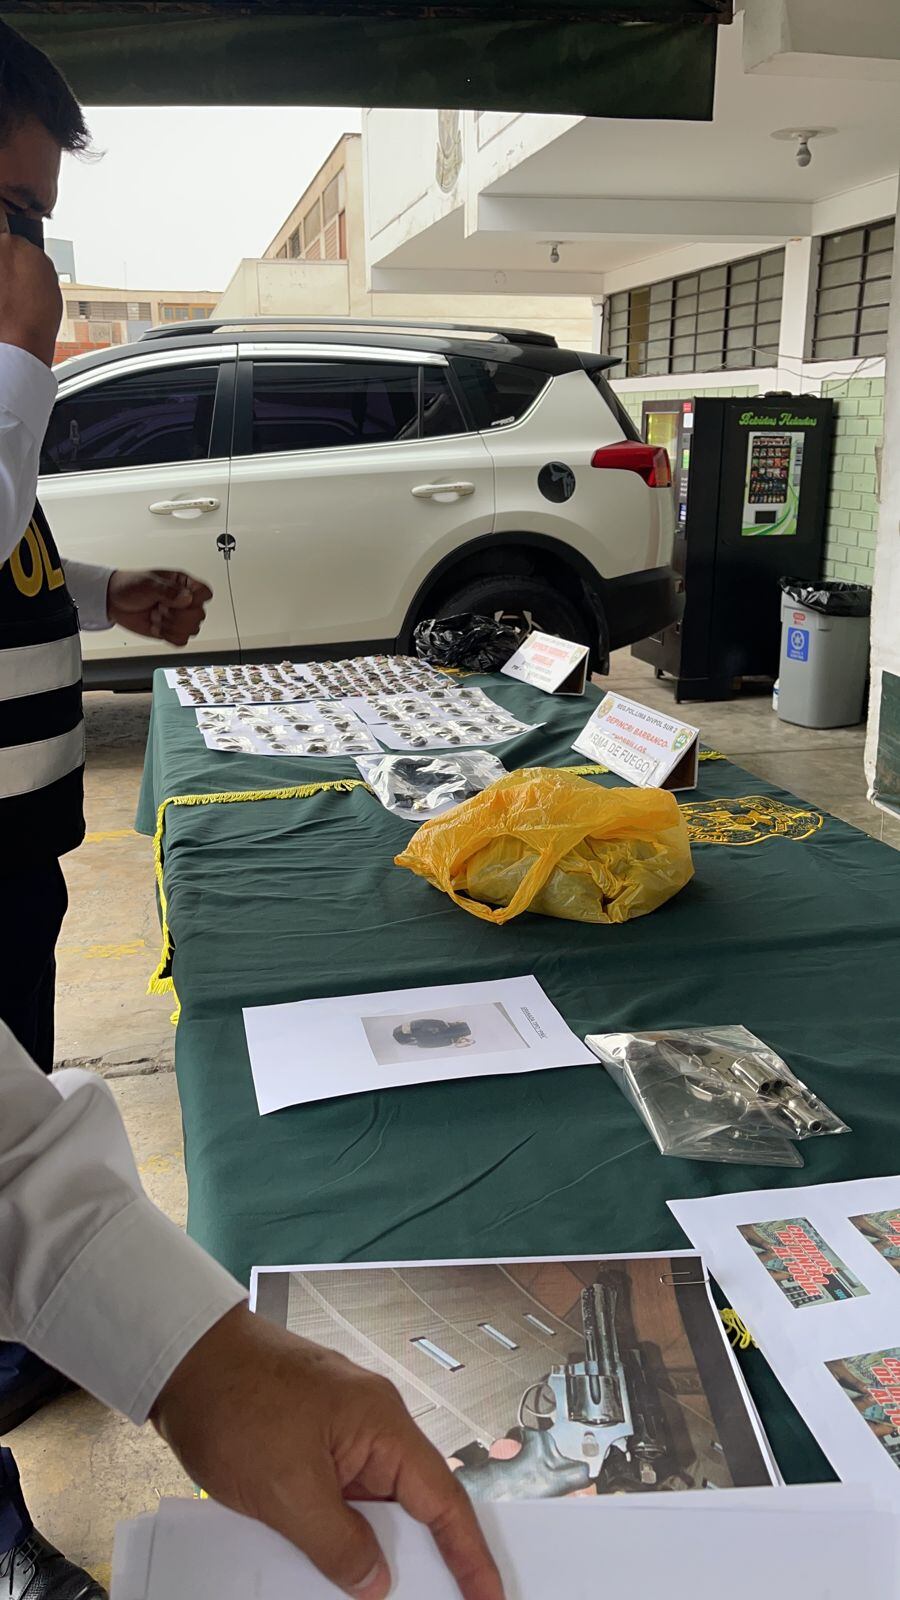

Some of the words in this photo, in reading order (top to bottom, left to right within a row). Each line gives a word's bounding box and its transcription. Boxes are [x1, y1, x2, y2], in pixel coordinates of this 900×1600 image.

[739, 412, 777, 426] Bebidas
[0, 517, 65, 597] OL
[607, 742, 622, 757] DE
[619, 749, 651, 773] FUEGO
[771, 1246, 795, 1260] AL
[783, 1261, 824, 1297] TOQUE
[775, 1230, 796, 1245] DE
[786, 1245, 830, 1285] DINERO
